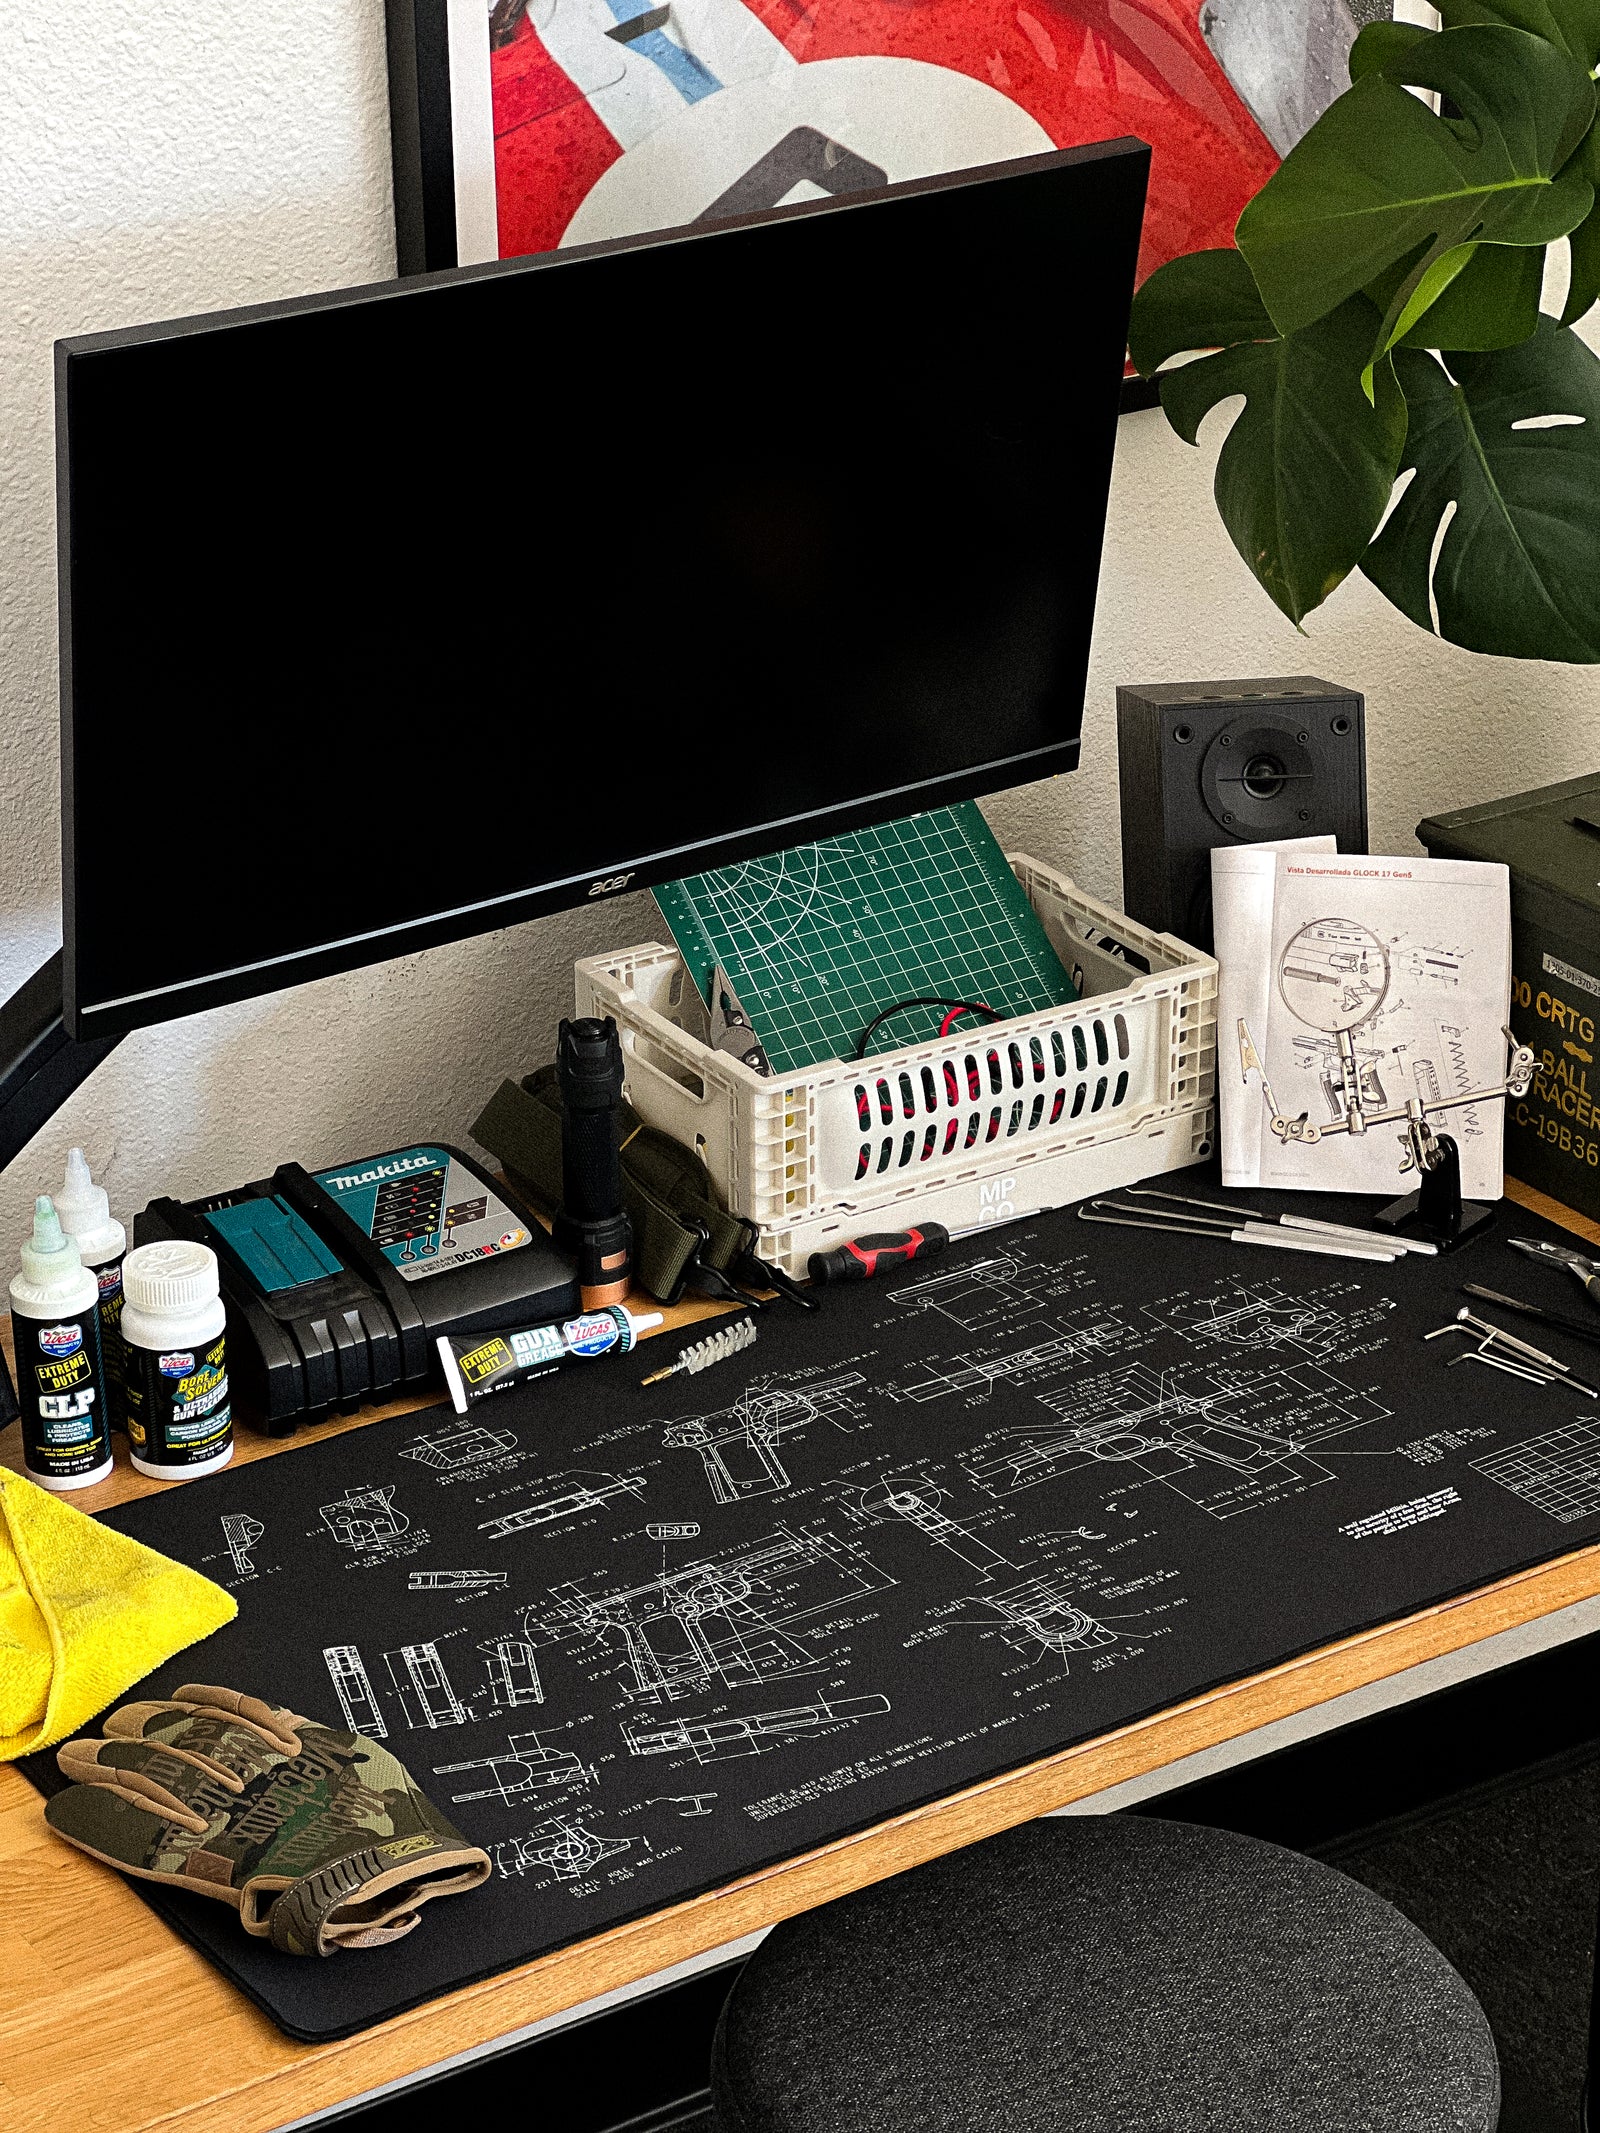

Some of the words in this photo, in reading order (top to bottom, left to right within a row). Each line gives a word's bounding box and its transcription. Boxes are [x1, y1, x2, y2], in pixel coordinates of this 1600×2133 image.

[1287, 866, 1304, 874] Vista
[1306, 867, 1351, 876] Desarrollada
[1353, 869, 1379, 877] GLOCK
[588, 872, 636, 896] acer
[1536, 991, 1595, 1043] CRTG
[979, 1177, 1017, 1206] MP
[454, 1243, 501, 1263] DC18RC
[98, 1274, 119, 1288] UCAS
[45, 1331, 78, 1344] LUCAS
[511, 1325, 562, 1354] GUN
[575, 1321, 611, 1341] LUCAS
[163, 1358, 190, 1367] LUCAS
[465, 1340, 504, 1370] EXTREME
[516, 1344, 566, 1368] GREASE
[38, 1354, 86, 1379] EXTREME
[477, 1357, 501, 1378] DUTY
[52, 1373, 80, 1389] DUTY
[179, 1369, 211, 1393] BORE
[38, 1387, 96, 1419] CLP
[173, 1408, 197, 1421] GUN
[188, 1440, 201, 1448] FOR
[80, 1455, 95, 1464] USA
[1344, 1521, 1359, 1530] well
[1359, 1511, 1386, 1525] regulated
[1107, 1537, 1138, 1554] SECTION
[226, 1572, 260, 1588] SECTION
[455, 1590, 490, 1605] SECTION
[826, 1617, 853, 1630] DETAIL
[856, 1613, 881, 1624] CATCH
[742, 1792, 787, 1812] TOLERANCE
[819, 1766, 853, 1782] ALLOWED
[854, 1760, 867, 1769] ON
[868, 1754, 884, 1763] ALL
[886, 1735, 933, 1757] DIMENSIONS
[754, 1800, 803, 1822] SUPERSEDES
[804, 1792, 820, 1802] OLD
[823, 1777, 858, 1794] TRACING
[891, 1755, 915, 1768] UNDER
[917, 1740, 955, 1758] REVISION
[957, 1731, 977, 1743] DATE
[979, 1726, 989, 1734] OF
[992, 1716, 1017, 1728] MARCH
[224, 1730, 356, 1847] Mechanix
[533, 1795, 569, 1813] SECTION
[748, 1802, 779, 1817] UNLESS
[780, 1785, 825, 1805] OTHERWISE
[568, 1879, 601, 1894] DETAIL
[636, 1857, 654, 1867] MAG
[656, 1845, 683, 1859] CATCH
[574, 1885, 602, 1899] SCALE
